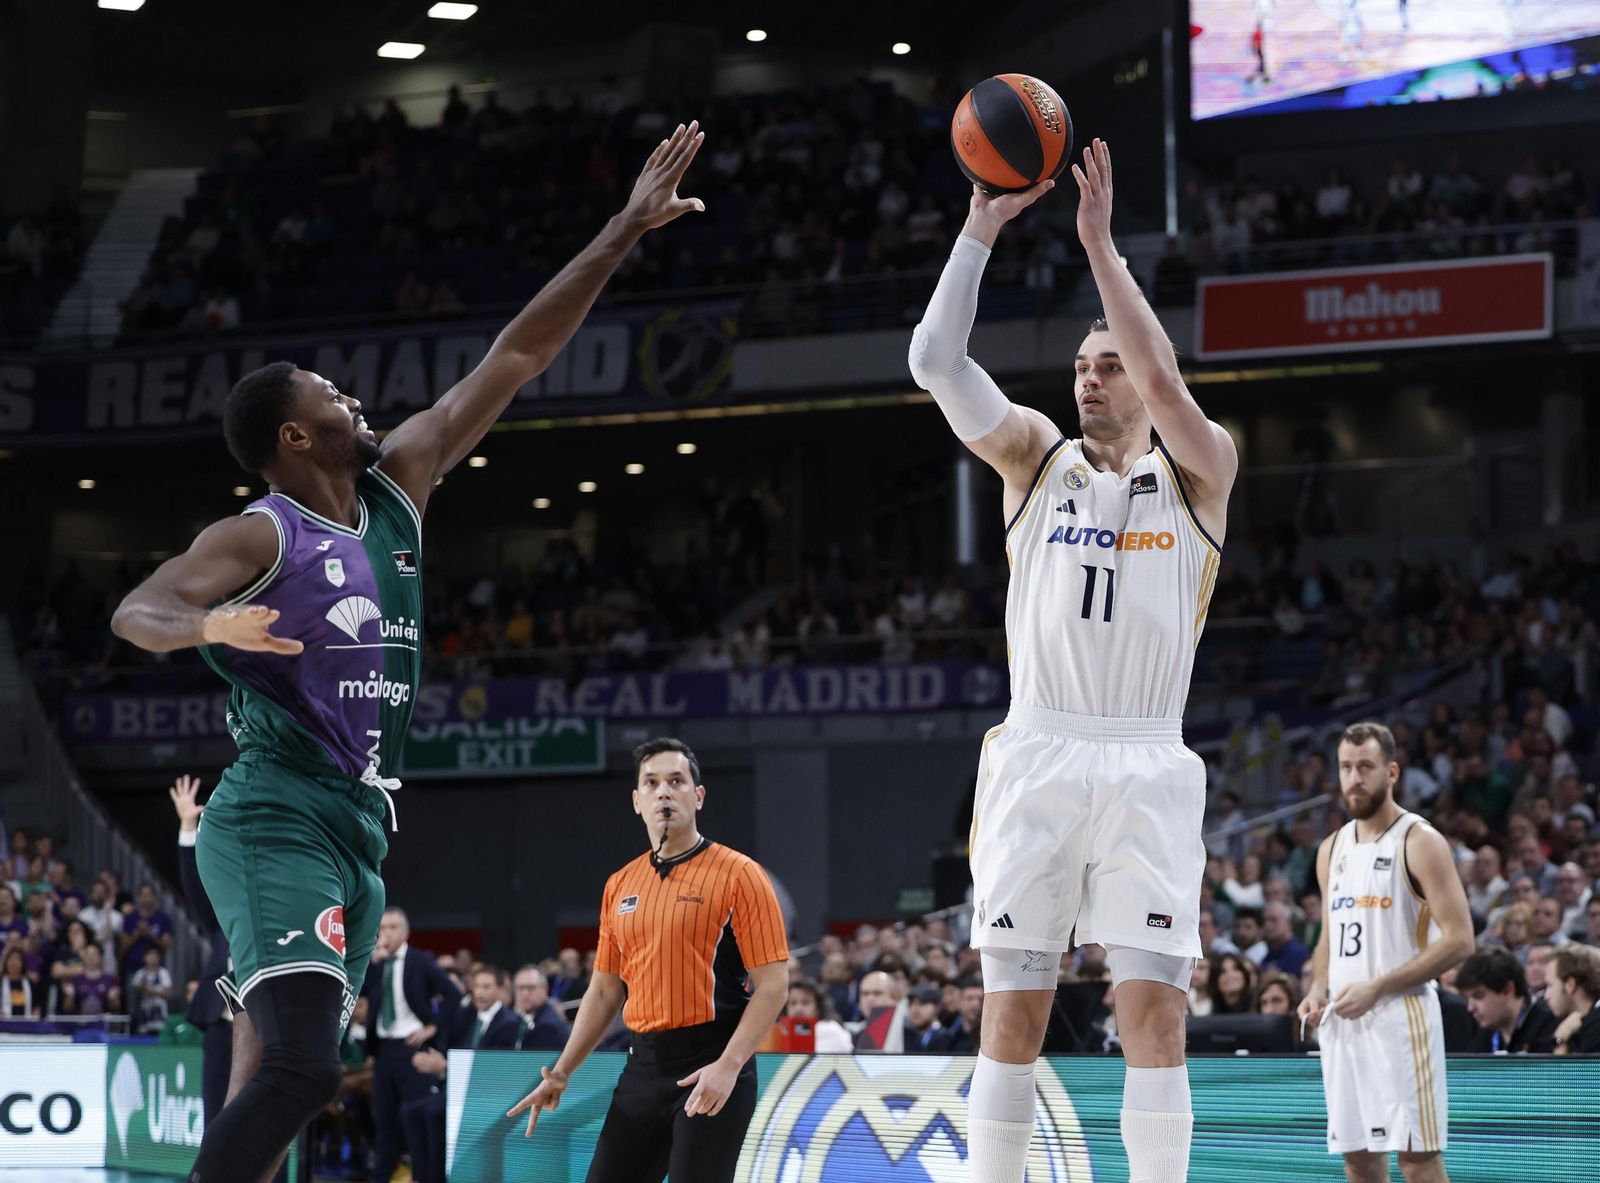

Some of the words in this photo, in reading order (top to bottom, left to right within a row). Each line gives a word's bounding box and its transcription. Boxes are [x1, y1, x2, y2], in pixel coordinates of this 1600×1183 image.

[1305, 282, 1440, 323] Mahou
[85, 349, 266, 430] REA
[1047, 525, 1175, 551] AUTOHERO
[1081, 564, 1115, 622] 11
[534, 672, 687, 716] REAL
[726, 663, 946, 715] MADRID
[458, 740, 533, 770] EXIT
[676, 895, 704, 905] SPALDING
[1149, 918, 1166, 927] acb
[1339, 921, 1362, 957] 13
[0, 1091, 82, 1136] CO
